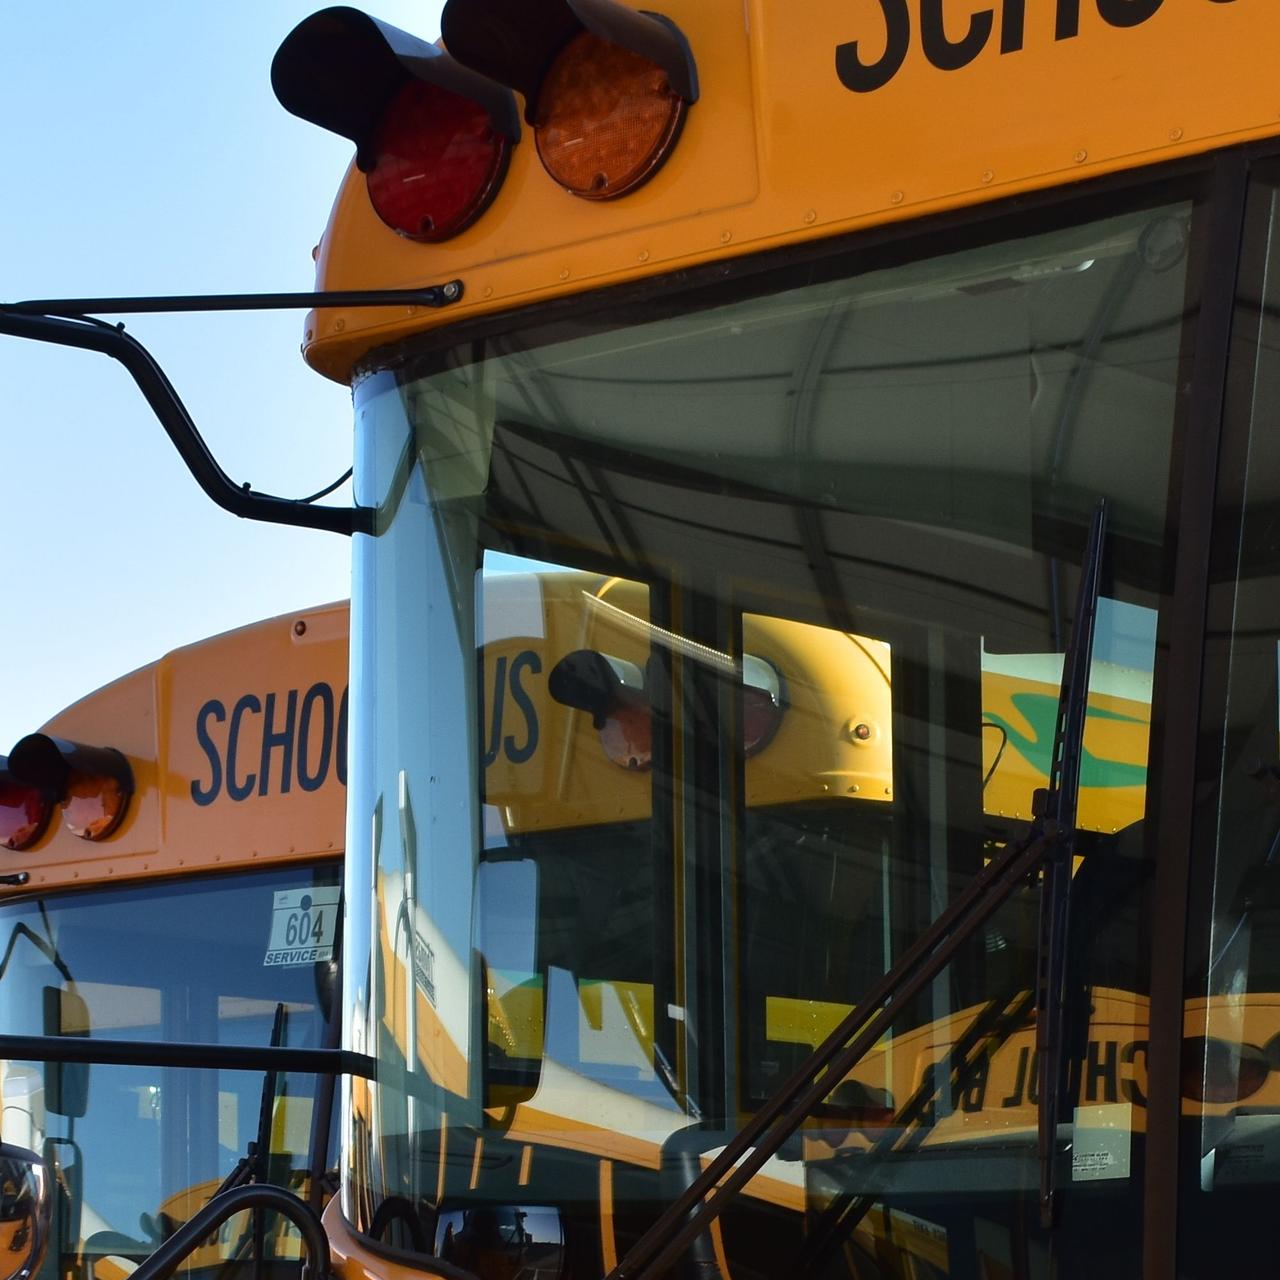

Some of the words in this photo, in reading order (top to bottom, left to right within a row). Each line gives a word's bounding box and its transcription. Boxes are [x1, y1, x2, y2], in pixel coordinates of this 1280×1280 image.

[191, 682, 347, 806] SCHO
[286, 909, 324, 946] 604
[265, 949, 318, 965] SERVICE
